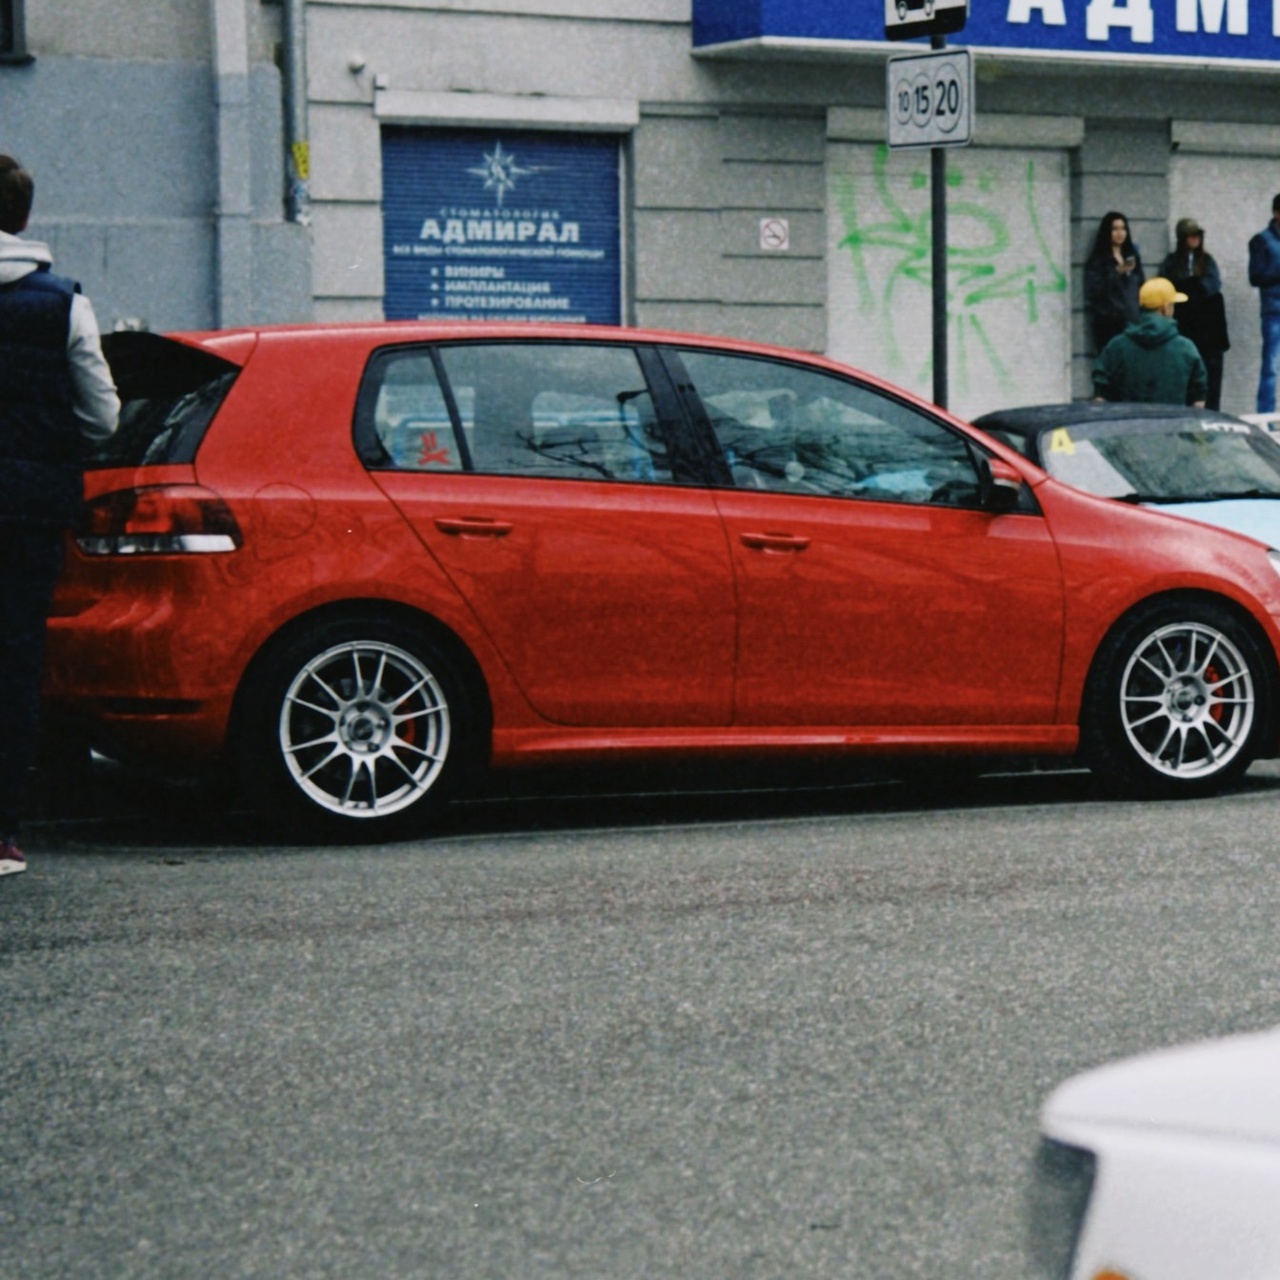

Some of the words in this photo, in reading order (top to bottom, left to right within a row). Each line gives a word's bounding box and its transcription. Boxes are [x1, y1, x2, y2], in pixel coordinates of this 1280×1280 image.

[898, 91, 909, 112] 10
[915, 85, 930, 114] 15
[935, 79, 959, 116] 20
[420, 218, 580, 244] АДМИРАЛ
[444, 281, 551, 295] ИМПЛАНТАЦИЯ
[444, 295, 570, 310] ПРОТЕЗИРОВАНИЕ
